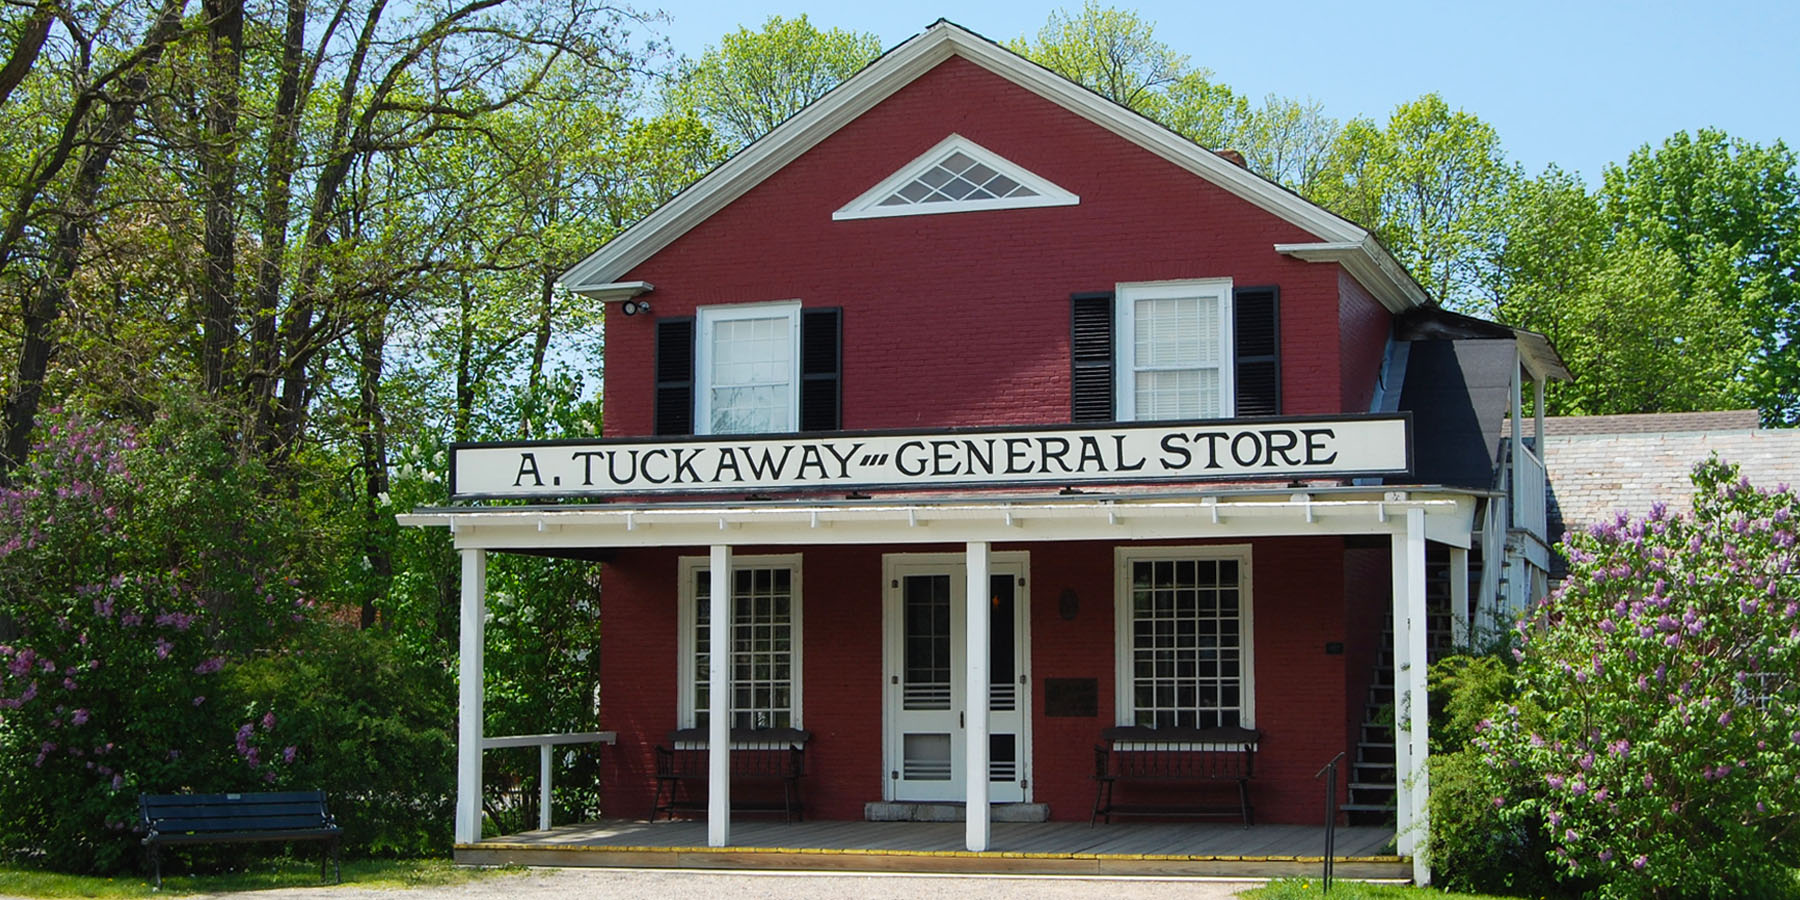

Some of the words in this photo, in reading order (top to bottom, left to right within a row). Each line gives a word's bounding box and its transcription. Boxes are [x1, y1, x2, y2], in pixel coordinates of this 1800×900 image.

[512, 452, 561, 487] A.
[571, 443, 864, 486] TUCKAWAY
[895, 434, 1147, 477] GENERAL
[1159, 428, 1338, 470] STORE
